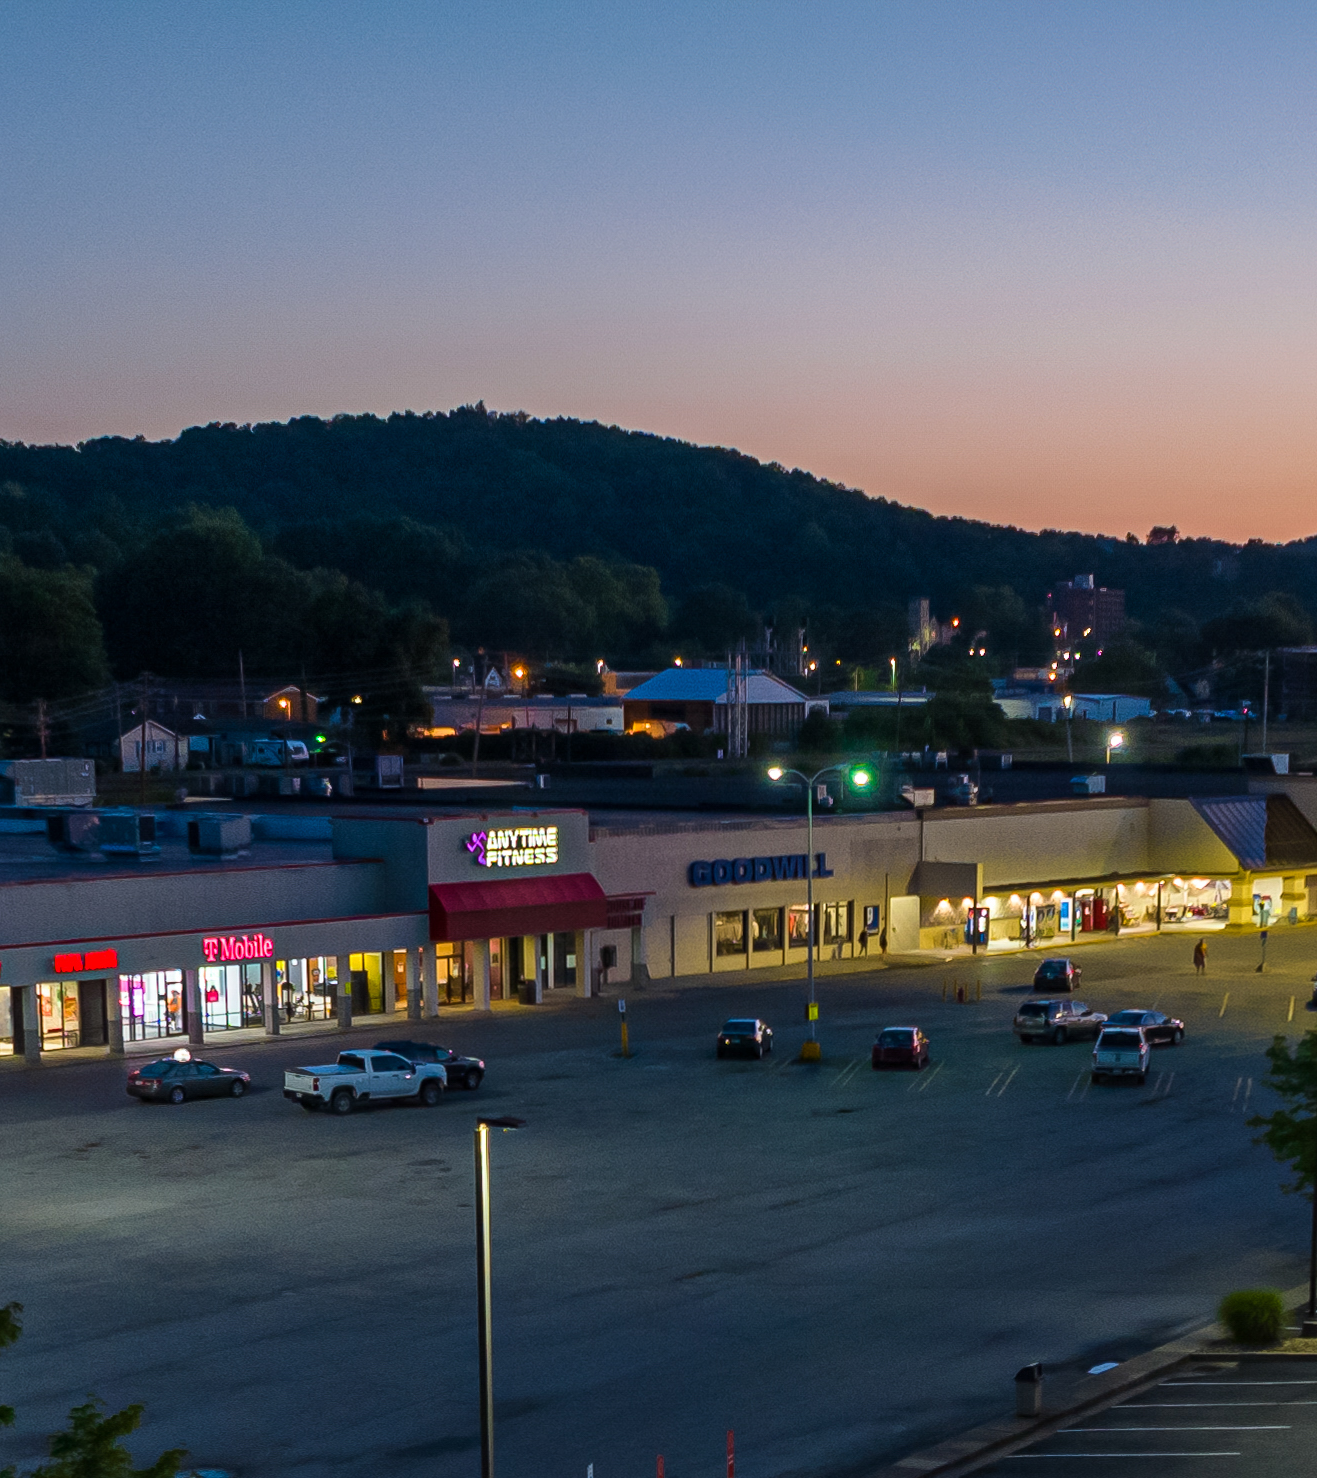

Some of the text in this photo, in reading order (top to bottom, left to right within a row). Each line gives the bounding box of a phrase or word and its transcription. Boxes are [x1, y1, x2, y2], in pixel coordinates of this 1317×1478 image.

[486, 826, 558, 850] ANYTIME
[486, 846, 558, 868] FITNESS
[688, 852, 834, 888] GOODWILL
